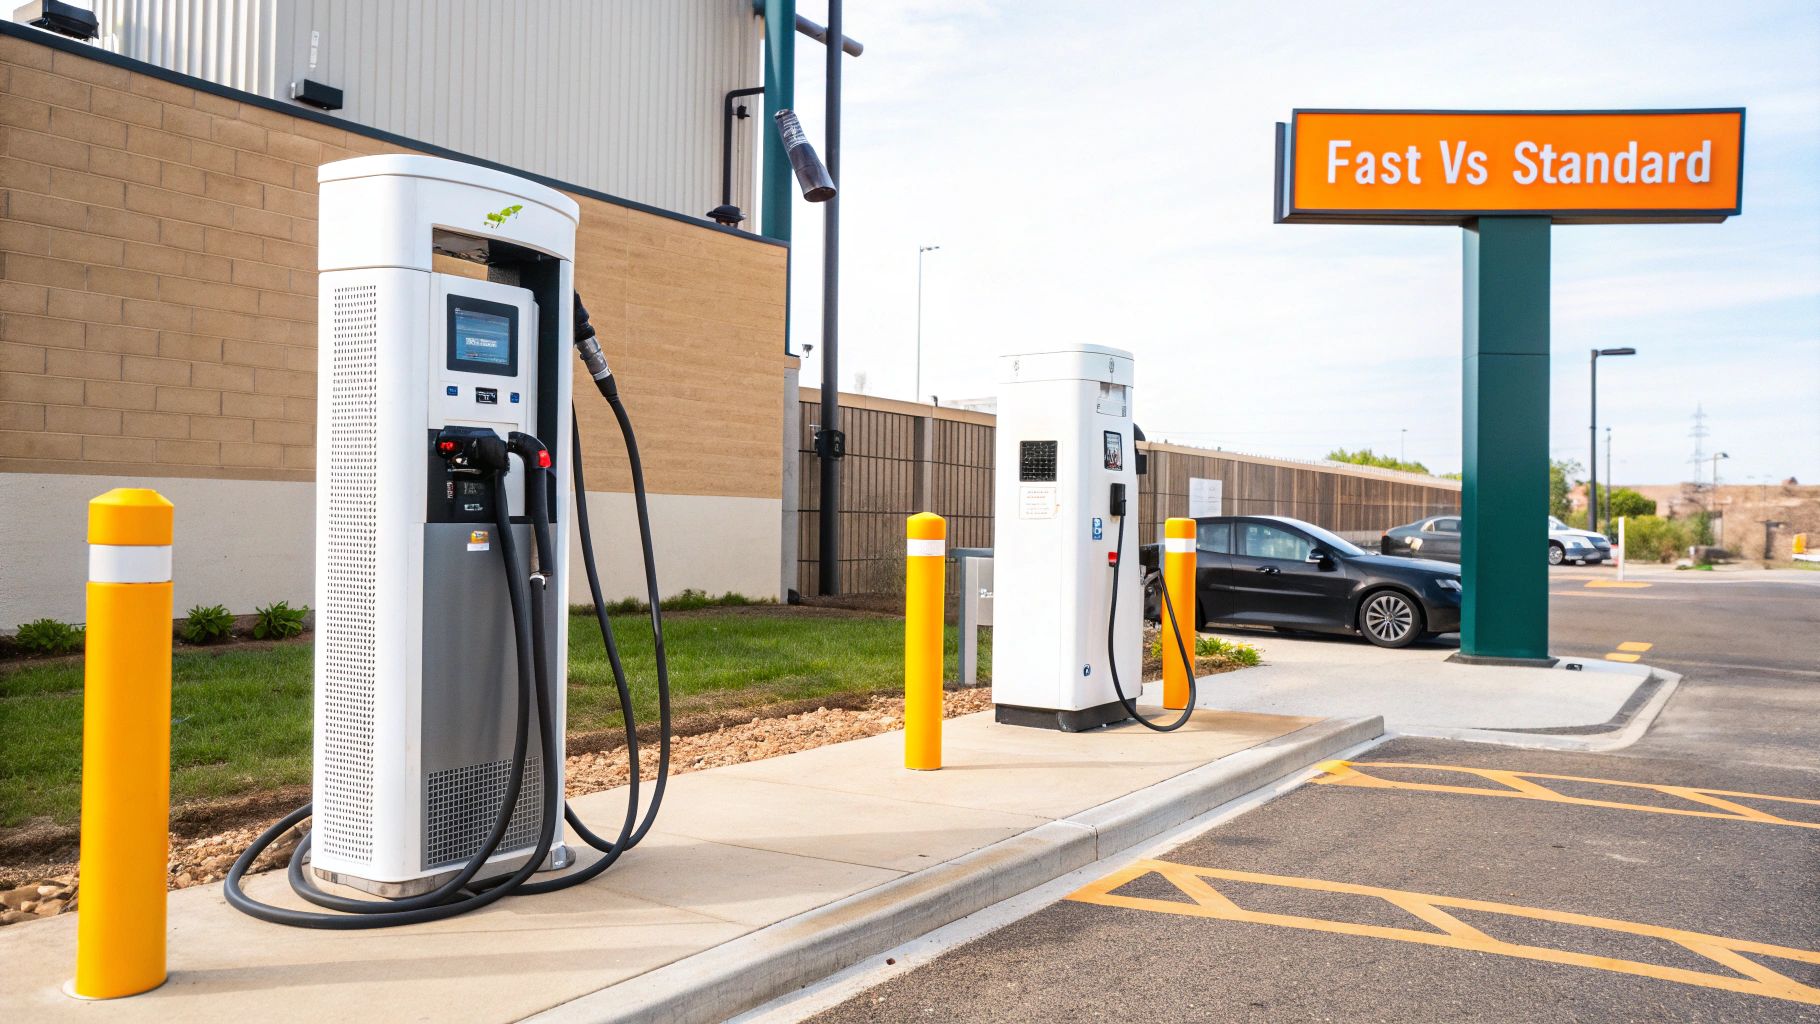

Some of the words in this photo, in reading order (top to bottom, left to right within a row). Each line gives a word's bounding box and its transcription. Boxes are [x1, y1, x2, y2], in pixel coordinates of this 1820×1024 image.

[1327, 139, 1421, 185] Fast
[1439, 140, 1488, 185] Vs
[1512, 139, 1712, 185] Standard
